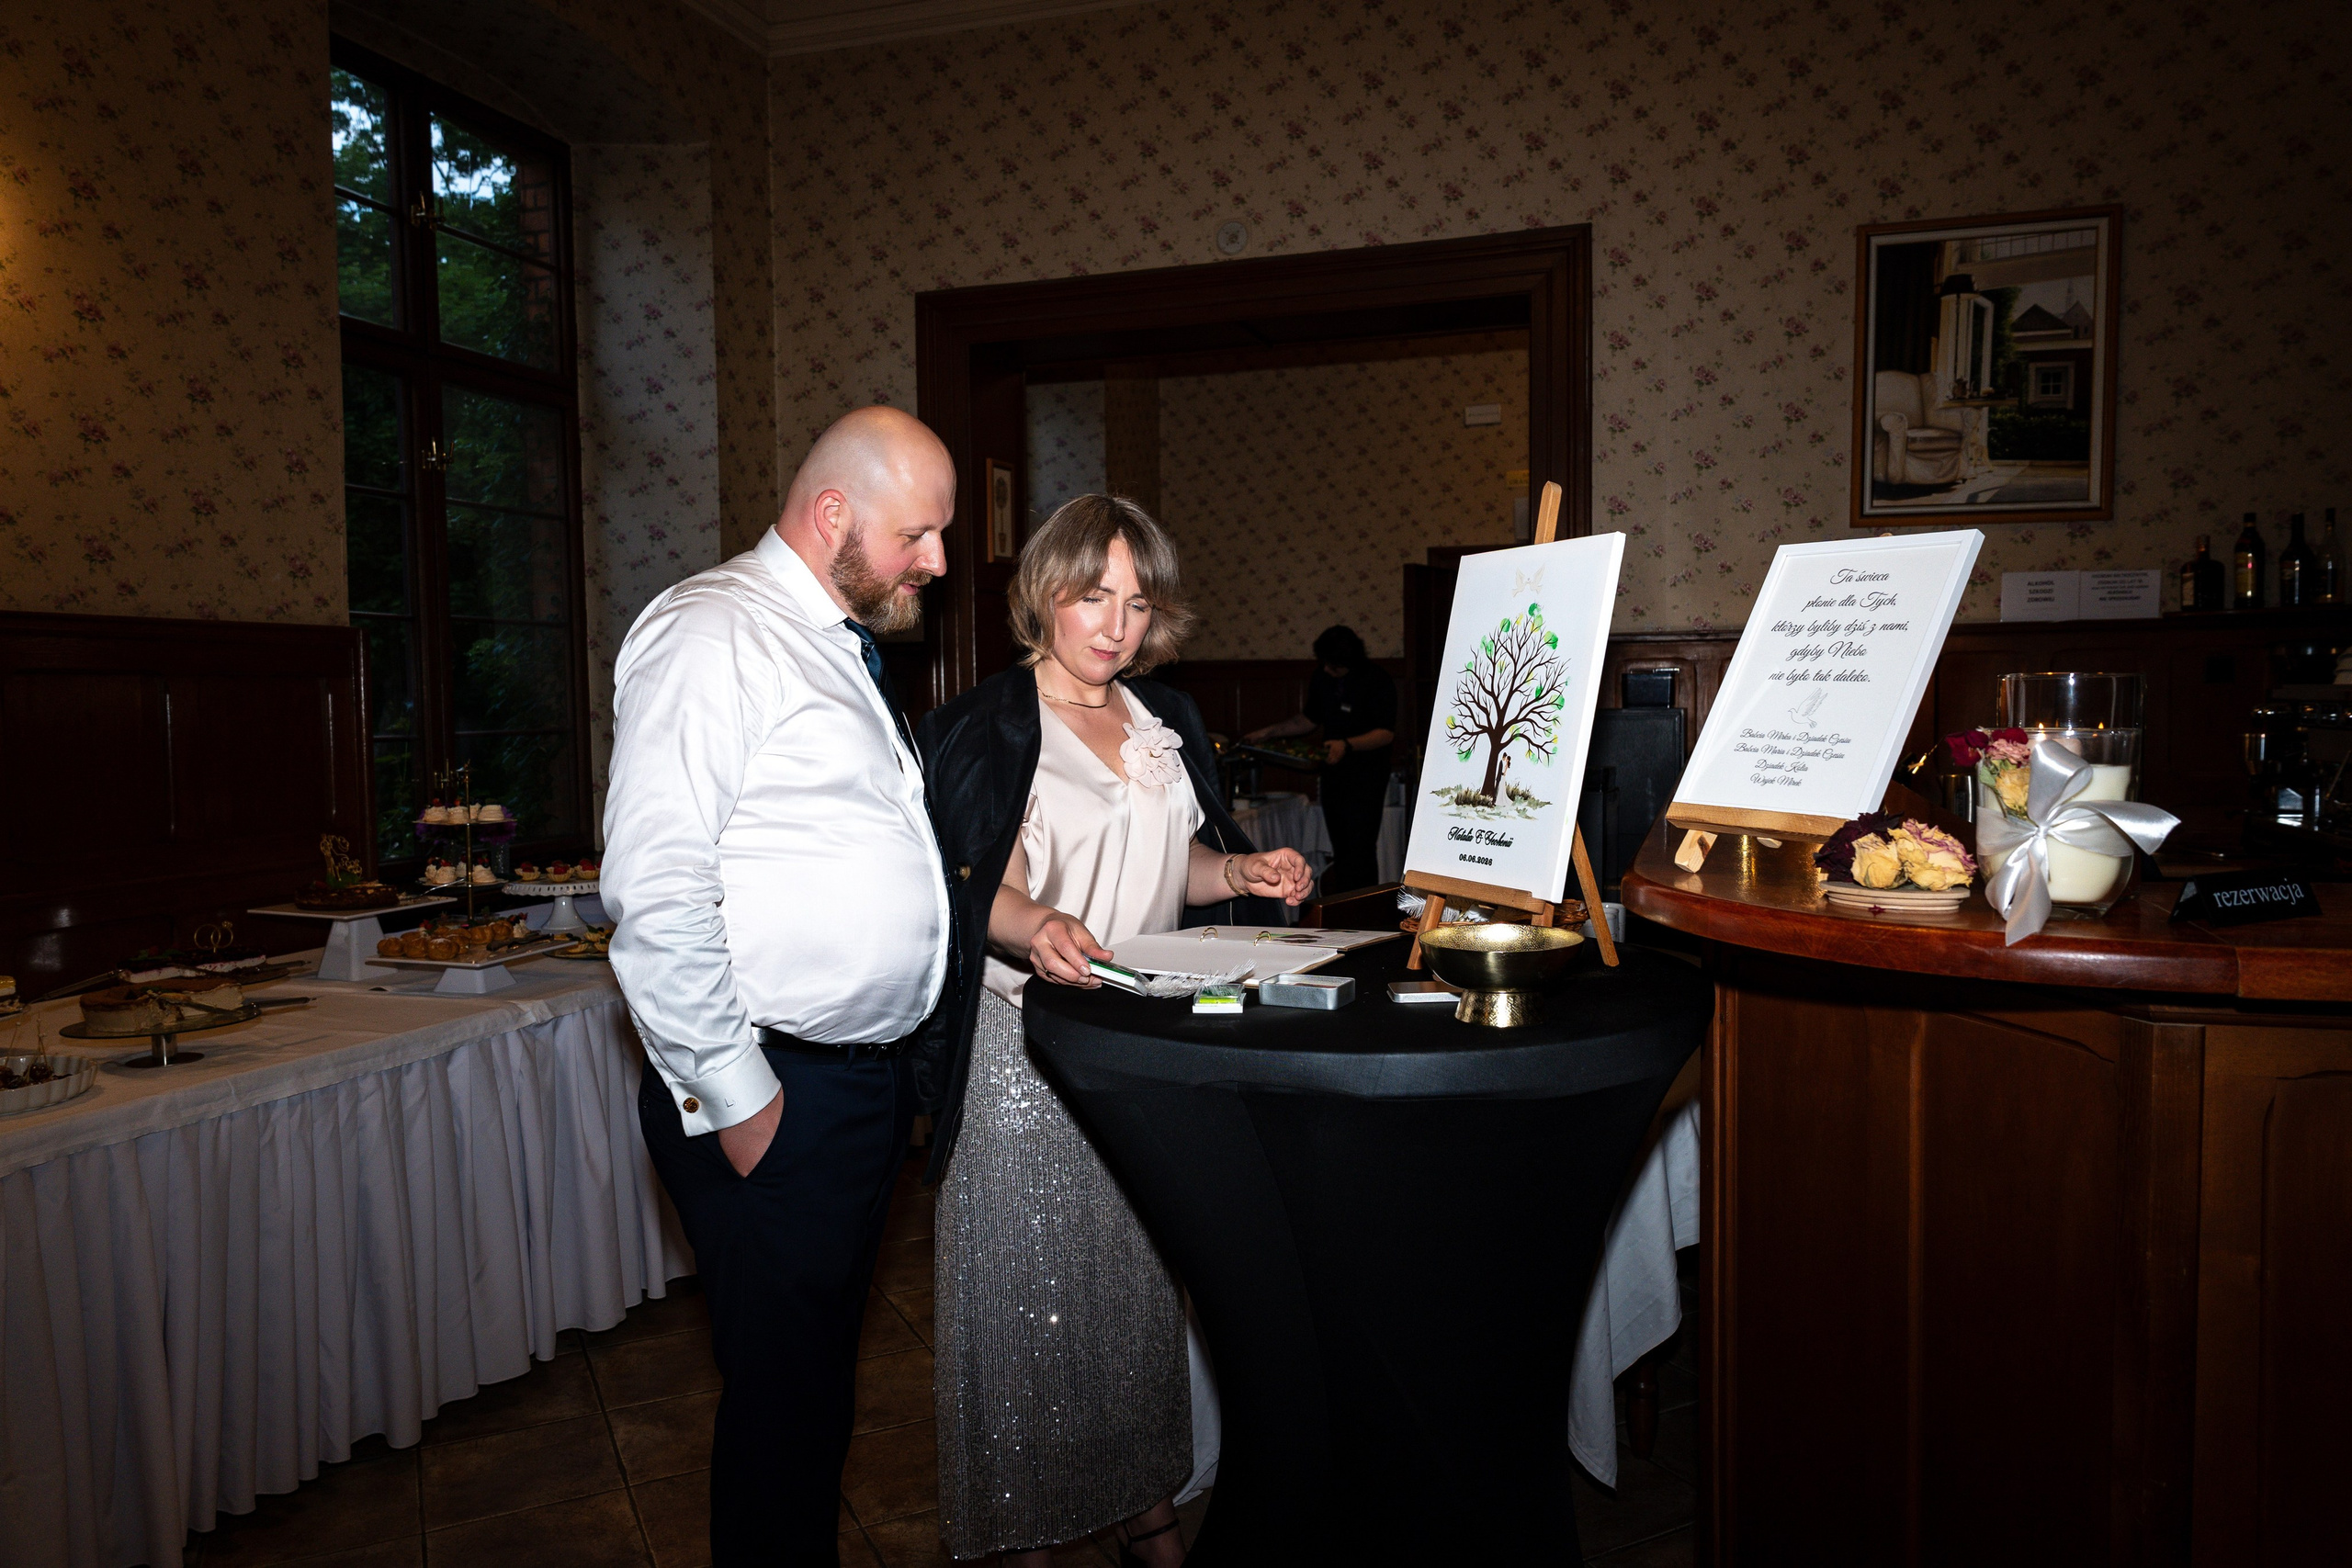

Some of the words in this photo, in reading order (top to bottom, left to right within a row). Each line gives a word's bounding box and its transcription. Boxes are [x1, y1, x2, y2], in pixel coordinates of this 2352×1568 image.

[1830, 569, 1858, 584] Ta
[1855, 570, 1890, 582] świeca
[1801, 595, 1837, 612] płonie
[1838, 594, 1857, 607] dla
[1771, 620, 1805, 637] którzy
[1807, 620, 1841, 637] byliby
[1843, 619, 1871, 637] dziś
[1863, 625, 1876, 637] z
[1785, 644, 1825, 661] gdyby
[1828, 641, 1867, 659] Niebo
[1768, 671, 1785, 681] nie
[1786, 669, 1810, 686] było
[1813, 669, 1832, 682] tak
[1833, 669, 1871, 682] daleko.
[1739, 728, 1766, 739] Babcia
[1767, 729, 1792, 740] Mirka
[1796, 731, 1828, 745] Dziadek
[1734, 742, 1759, 753] Babcia
[1760, 744, 1786, 755] Maria
[1790, 746, 1822, 759] Dziadek
[1754, 759, 1784, 772] Dziadek
[2212, 877, 2304, 908] rezerwacja
